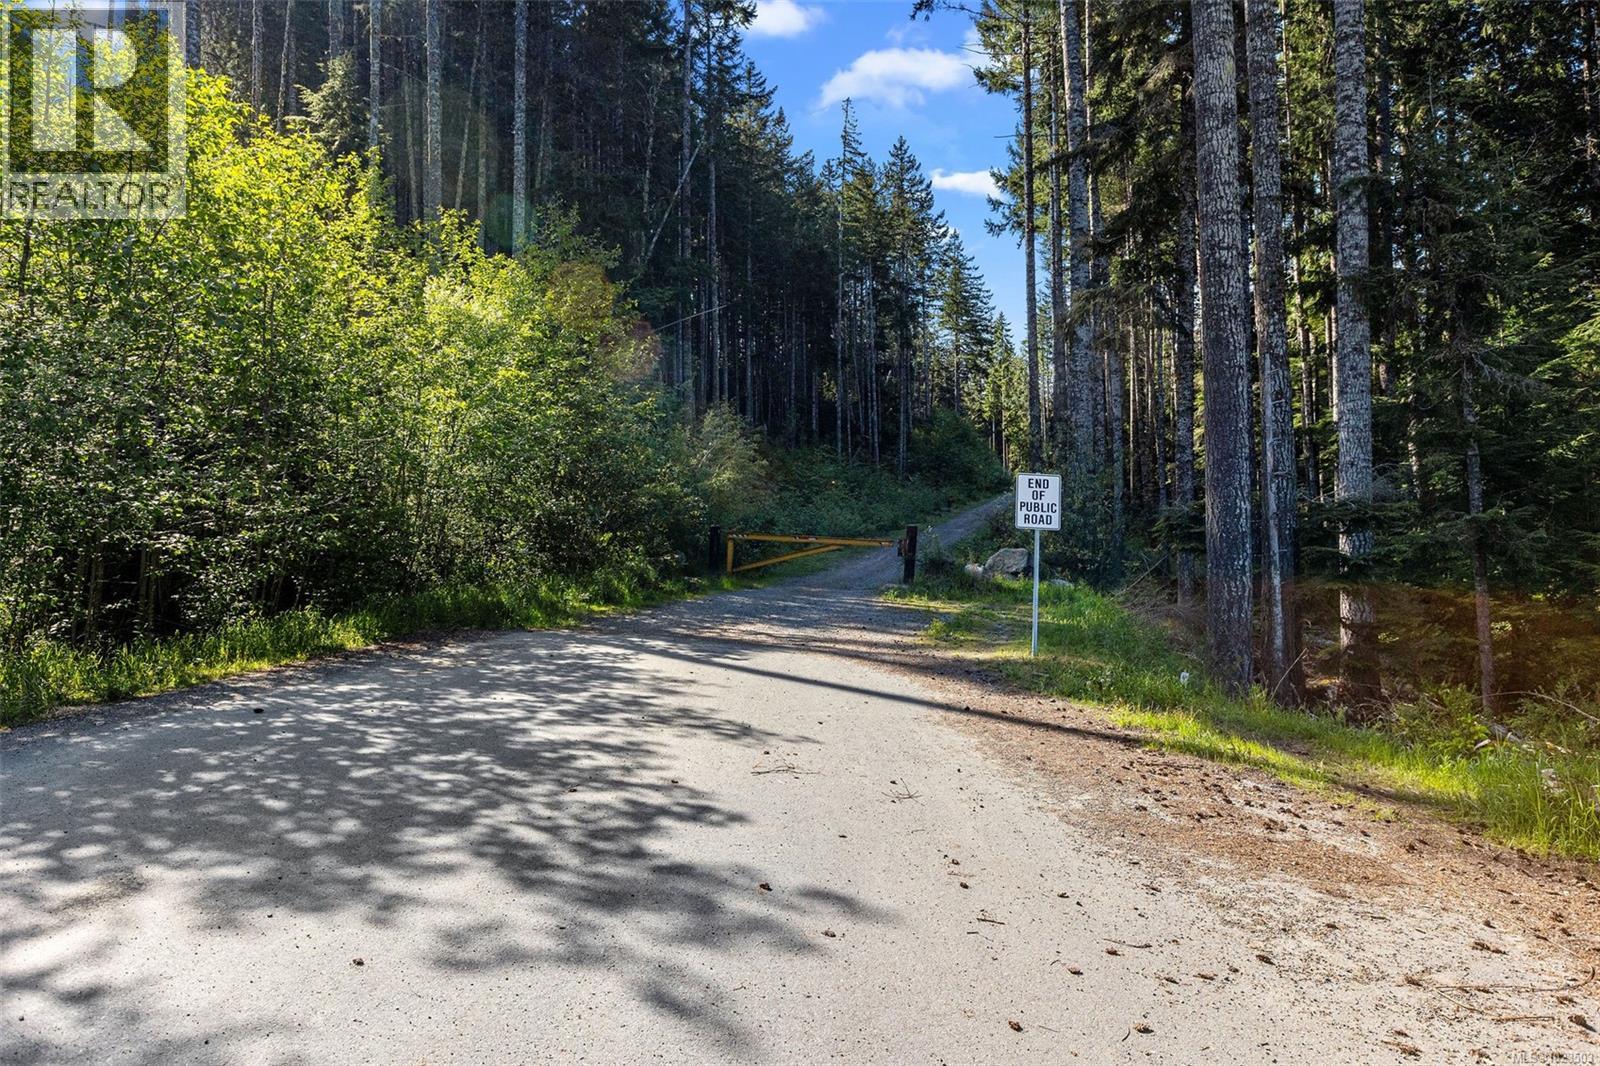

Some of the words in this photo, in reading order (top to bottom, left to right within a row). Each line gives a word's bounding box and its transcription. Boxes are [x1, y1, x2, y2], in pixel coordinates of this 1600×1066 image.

[1028, 478, 1049, 489] END
[1032, 490, 1046, 501] OF
[1019, 501, 1057, 513] PUBLIC
[1024, 514, 1052, 525] ROAD
